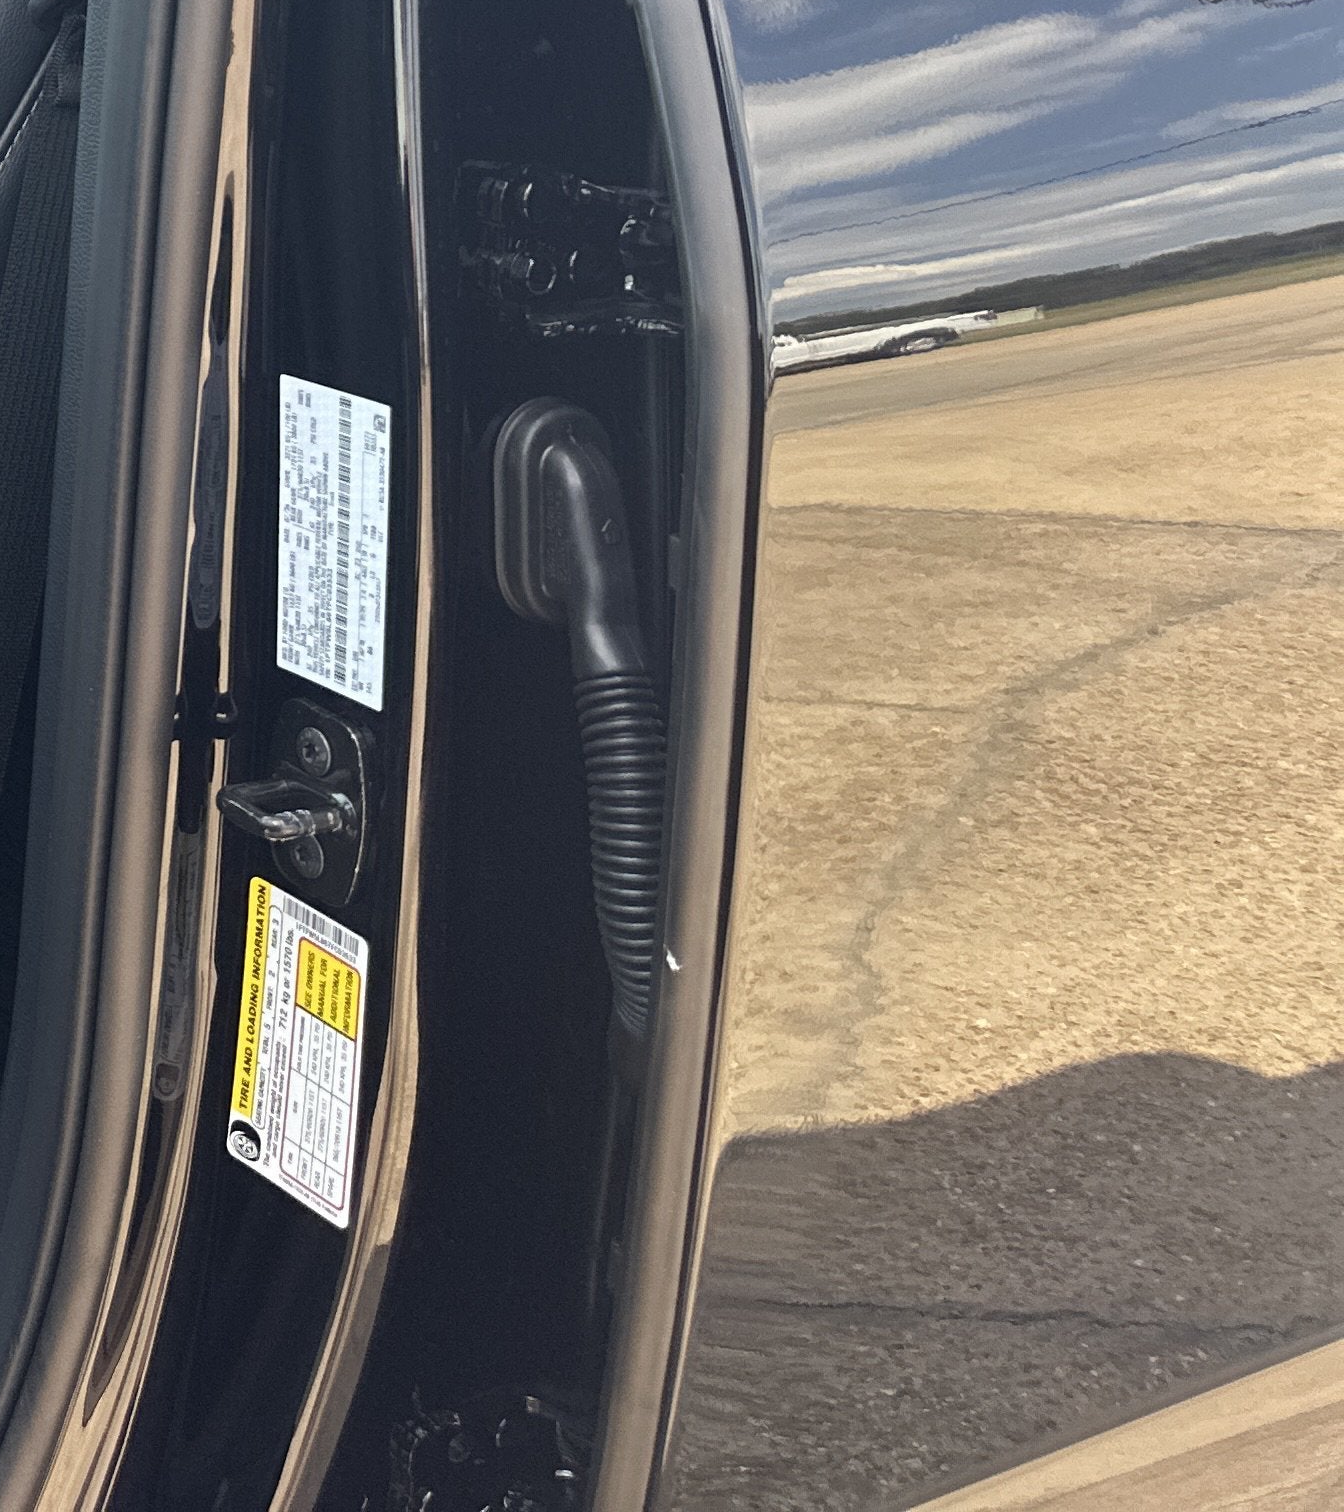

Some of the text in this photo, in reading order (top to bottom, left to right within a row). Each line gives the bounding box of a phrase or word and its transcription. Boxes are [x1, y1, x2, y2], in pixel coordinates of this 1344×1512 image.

[285, 928, 294, 946] lbs.
[284, 947, 292, 974] 1570
[239, 884, 266, 1108] TIRE AND LOADING INFORMATION
[281, 991, 290, 1005] kg
[317, 981, 326, 1017] MANUAL
[330, 970, 340, 1023] ADDITIONAL
[343, 970, 353, 1033] INFORMATION
[279, 1008, 287, 1029] 712
